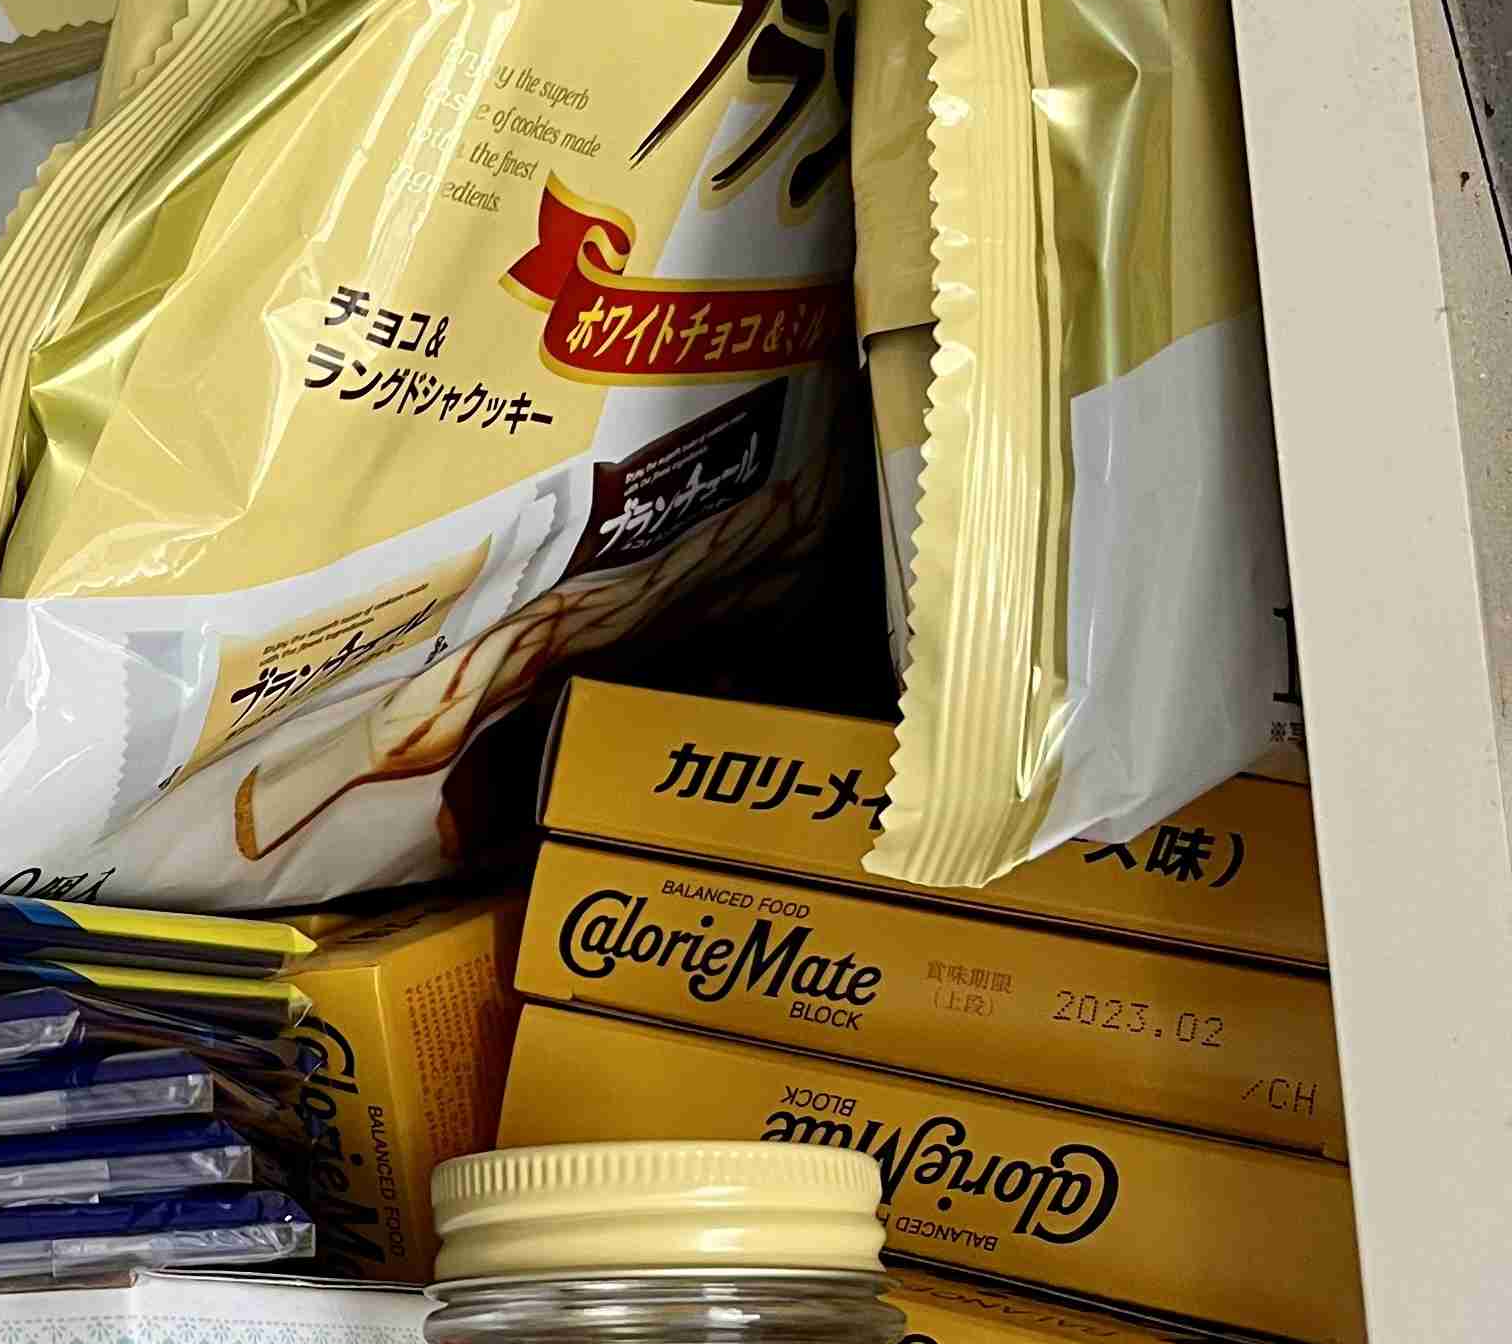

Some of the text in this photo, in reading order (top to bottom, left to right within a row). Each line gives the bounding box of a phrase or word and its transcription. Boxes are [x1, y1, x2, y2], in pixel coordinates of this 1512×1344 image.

[515, 67, 541, 94] the
[539, 80, 590, 111] superb
[492, 107, 517, 134] of
[510, 115, 560, 145] cookies
[560, 132, 602, 158] made
[469, 141, 499, 168] the
[492, 150, 539, 181] finest
[322, 284, 446, 358] チョコ&
[303, 343, 554, 435] ラングドシャクッキー
[662, 879, 810, 920] BALANCED FOOD
[924, 959, 1014, 995] 賞味期限
[789, 1002, 861, 1031] BLOCK
[1053, 990, 1225, 1050] 2023.02
[780, 1086, 857, 1118] BLOCK
[896, 1216, 998, 1252] BALANCED
